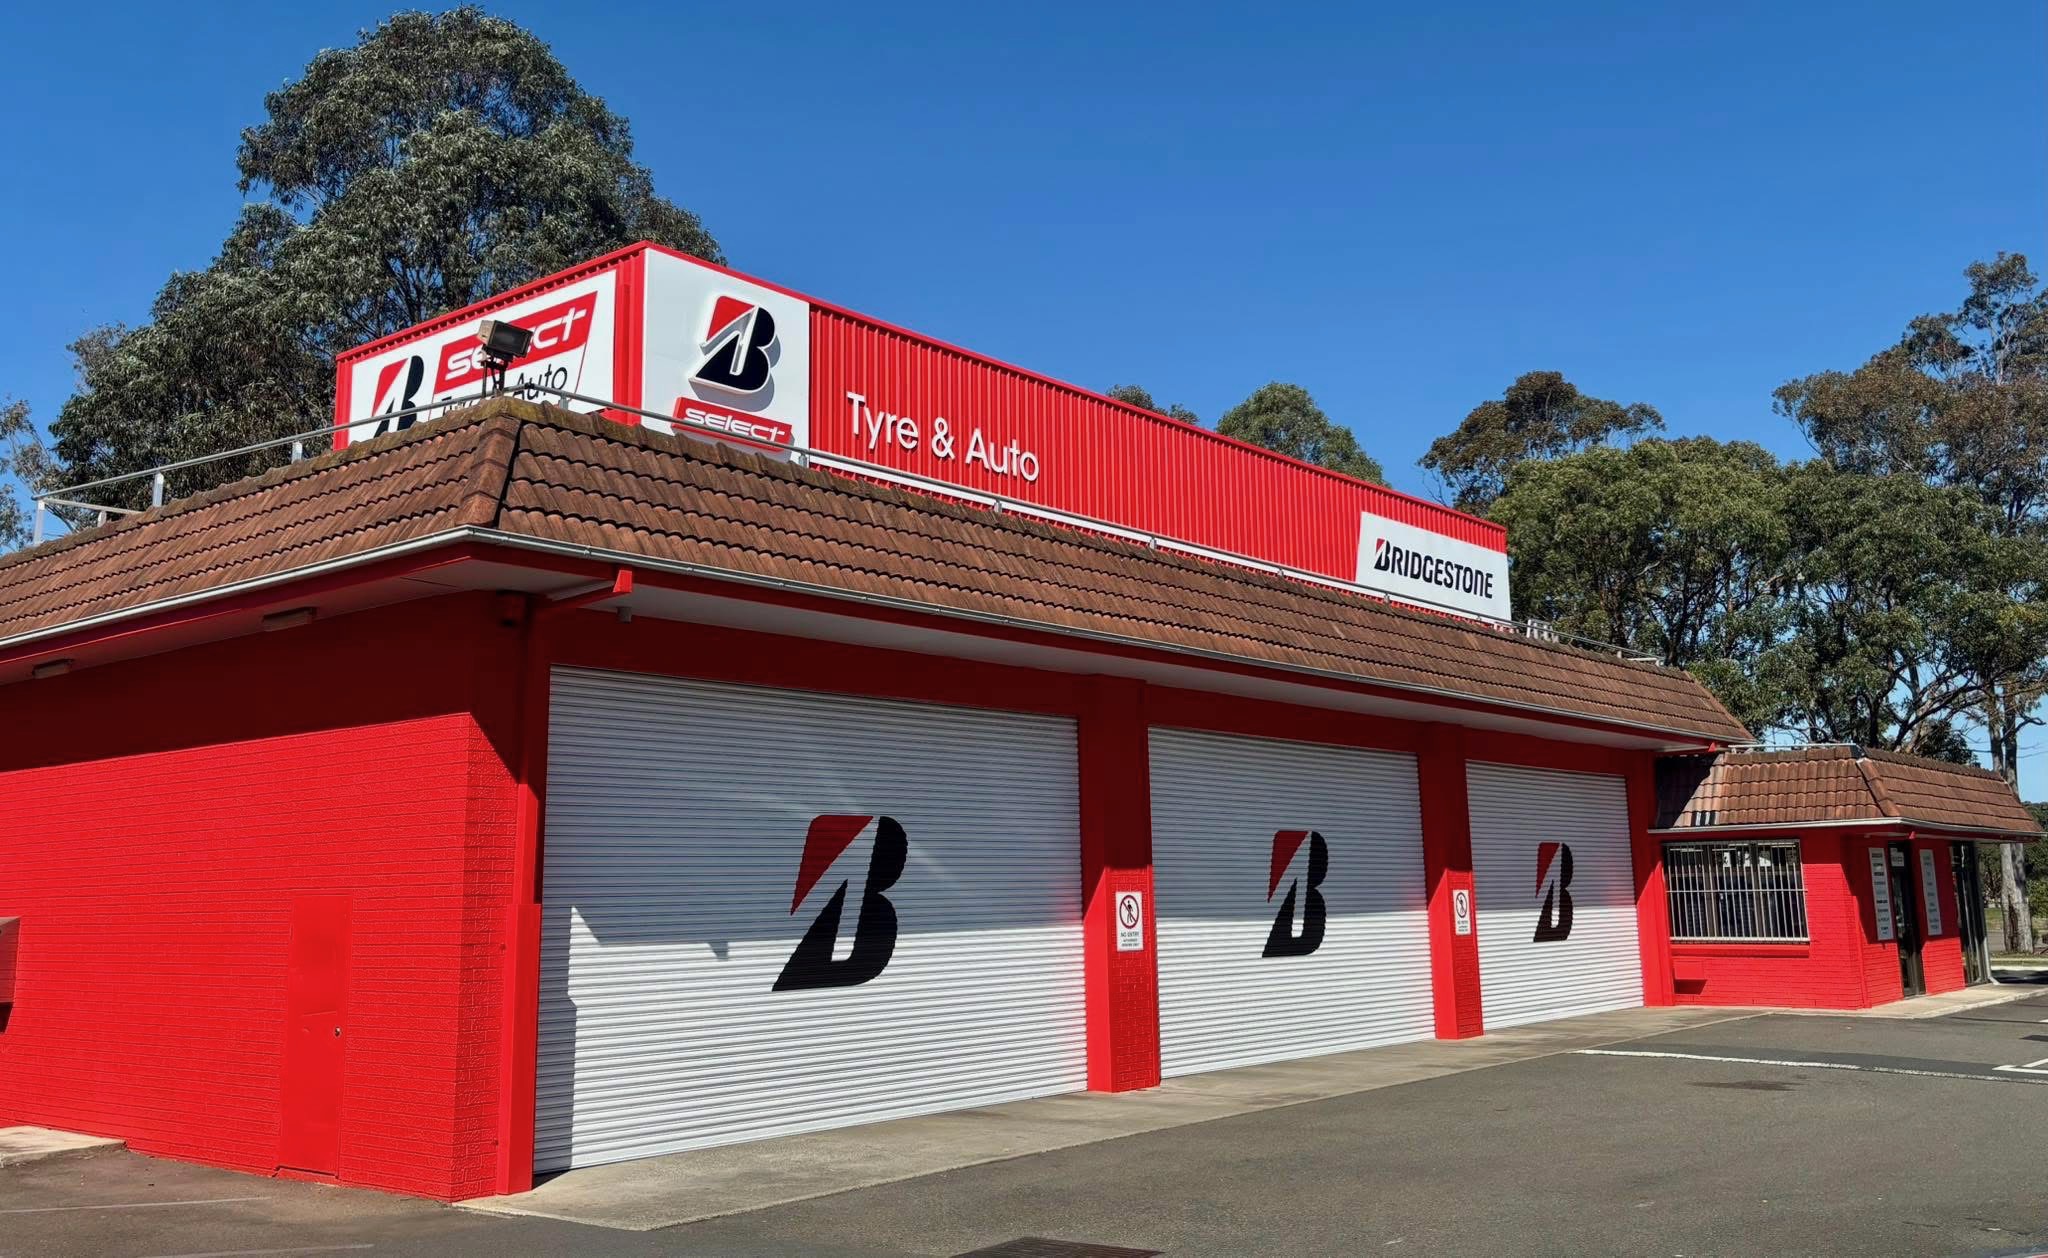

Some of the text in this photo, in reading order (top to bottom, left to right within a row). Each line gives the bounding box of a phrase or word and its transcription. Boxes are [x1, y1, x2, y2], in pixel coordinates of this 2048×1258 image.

[445, 307, 587, 381] sect
[512, 363, 567, 401] Auto
[846, 391, 1040, 482] Tyre & Auto
[1374, 538, 1493, 599] BRIDGESTONE
